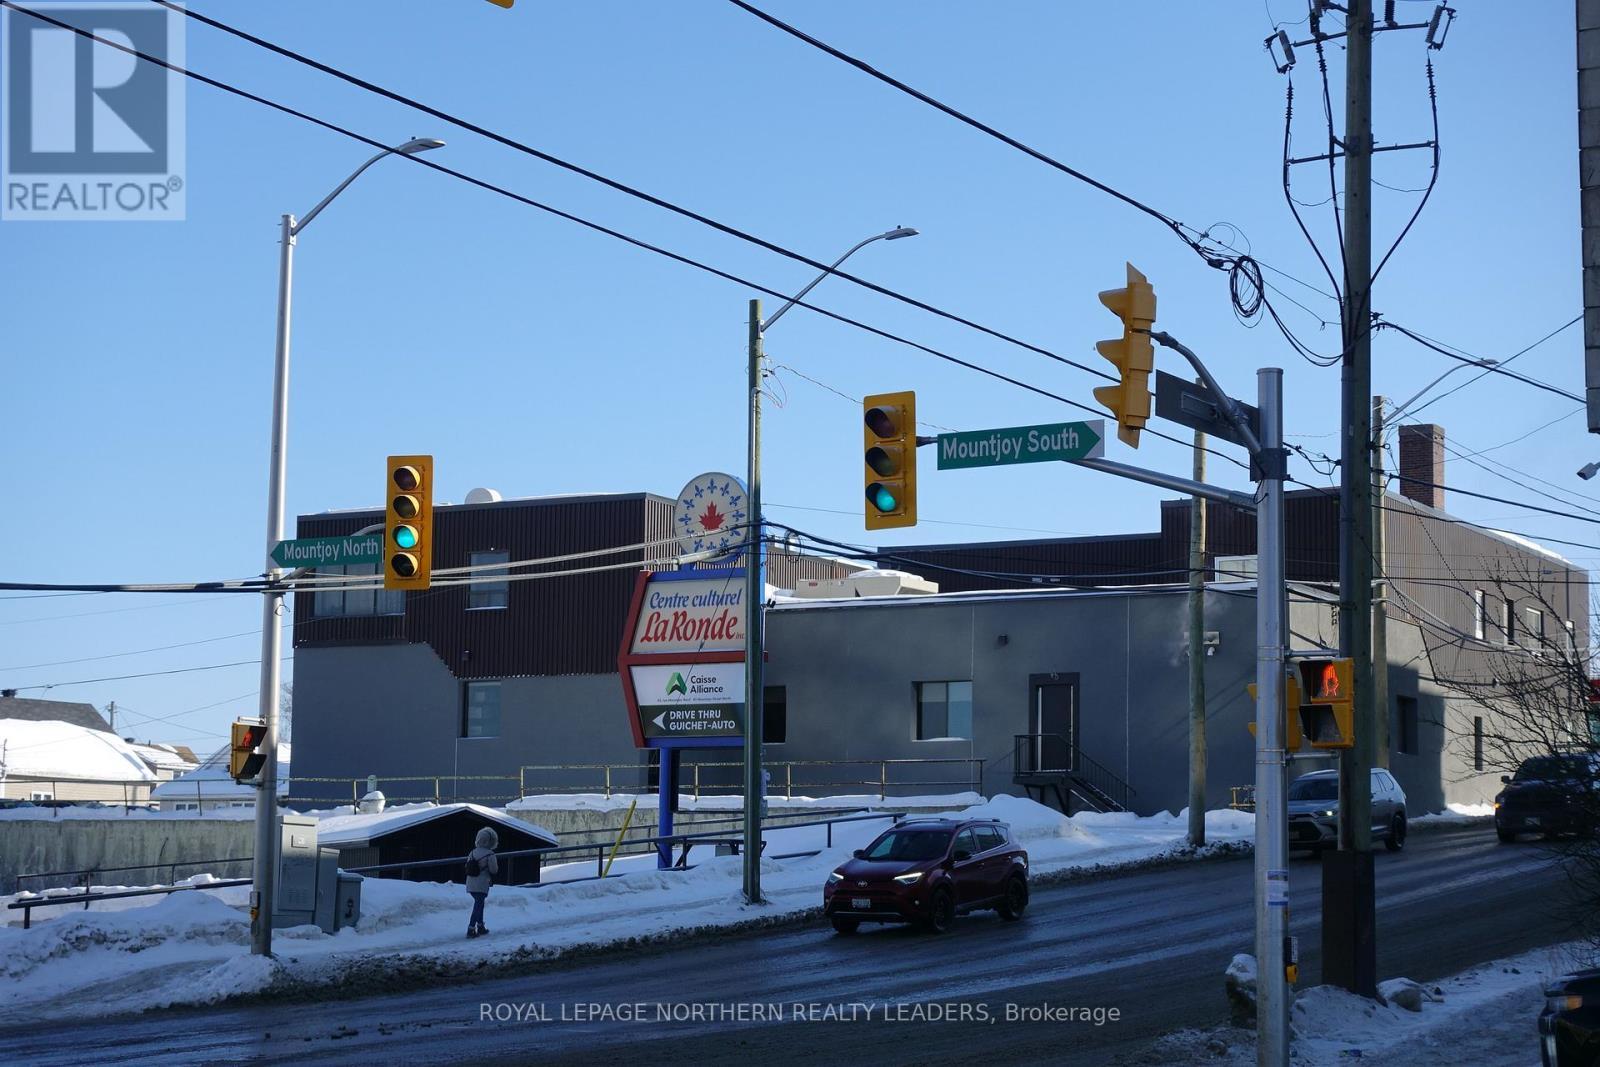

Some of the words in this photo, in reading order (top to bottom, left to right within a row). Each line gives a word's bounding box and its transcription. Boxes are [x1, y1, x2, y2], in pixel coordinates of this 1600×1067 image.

[943, 434, 1023, 462] Mountjoy
[1027, 427, 1079, 453] South
[284, 541, 340, 562] Mountjoy
[343, 538, 378, 556] North
[650, 592, 689, 609] Centre
[692, 588, 742, 607] culturel
[690, 675, 717, 684] Caisse
[690, 684, 724, 694] Alliance
[669, 710, 696, 720] DRIVE
[698, 709, 721, 719] THRU
[669, 720, 736, 731] GUICHET-AUTO
